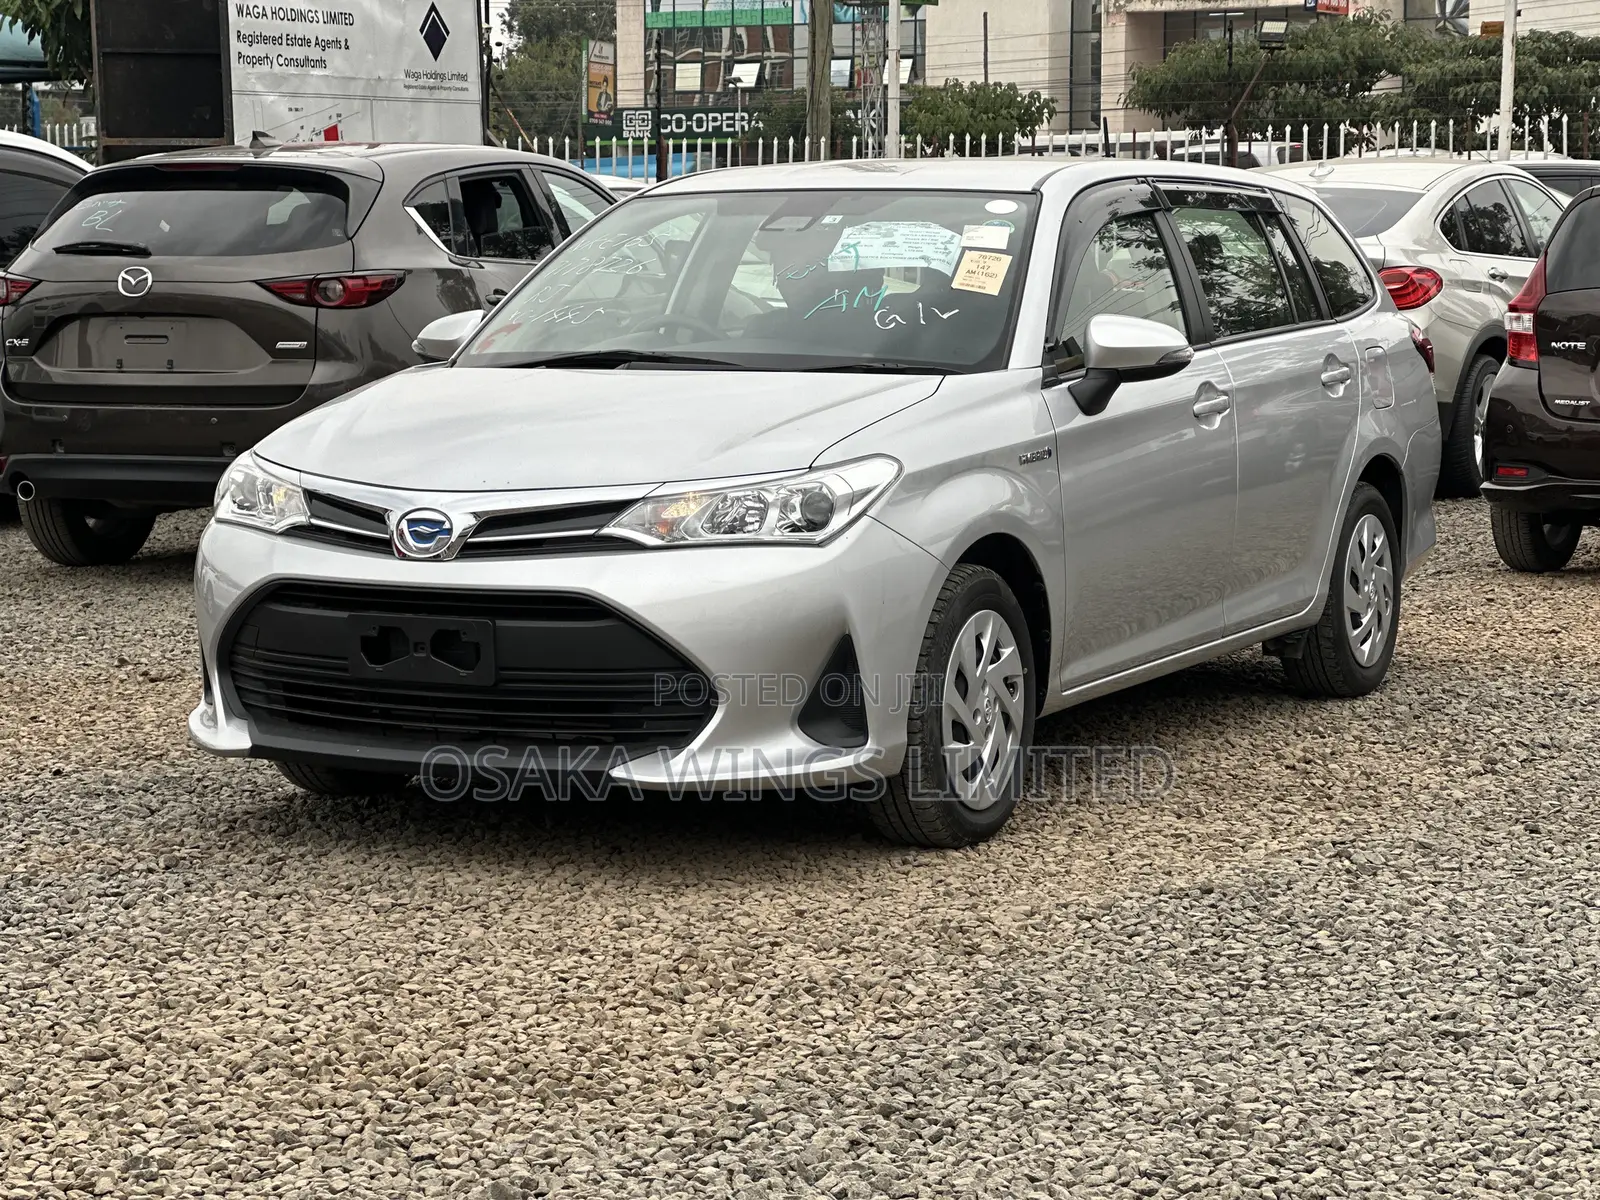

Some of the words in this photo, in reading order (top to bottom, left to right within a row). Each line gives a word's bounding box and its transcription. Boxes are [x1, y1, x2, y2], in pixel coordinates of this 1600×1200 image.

[236, 3, 268, 20] WAGA
[270, 6, 320, 24] HOLDINGS
[322, 10, 355, 26] LIMITED
[236, 30, 283, 47] Registered
[286, 33, 312, 48] Estate
[314, 35, 342, 51] Agents
[344, 38, 350, 50] &
[237, 51, 274, 69] Property
[276, 53, 328, 69] Consultants
[403, 69, 422, 81] Waga
[422, 70, 447, 82] Holdings
[447, 70, 468, 82] Limited
[660, 112, 764, 133] CO-OPERA
[622, 130, 651, 138] BANK
[5, 338, 30, 347] CX-5
[1550, 341, 1587, 350] NOTE
